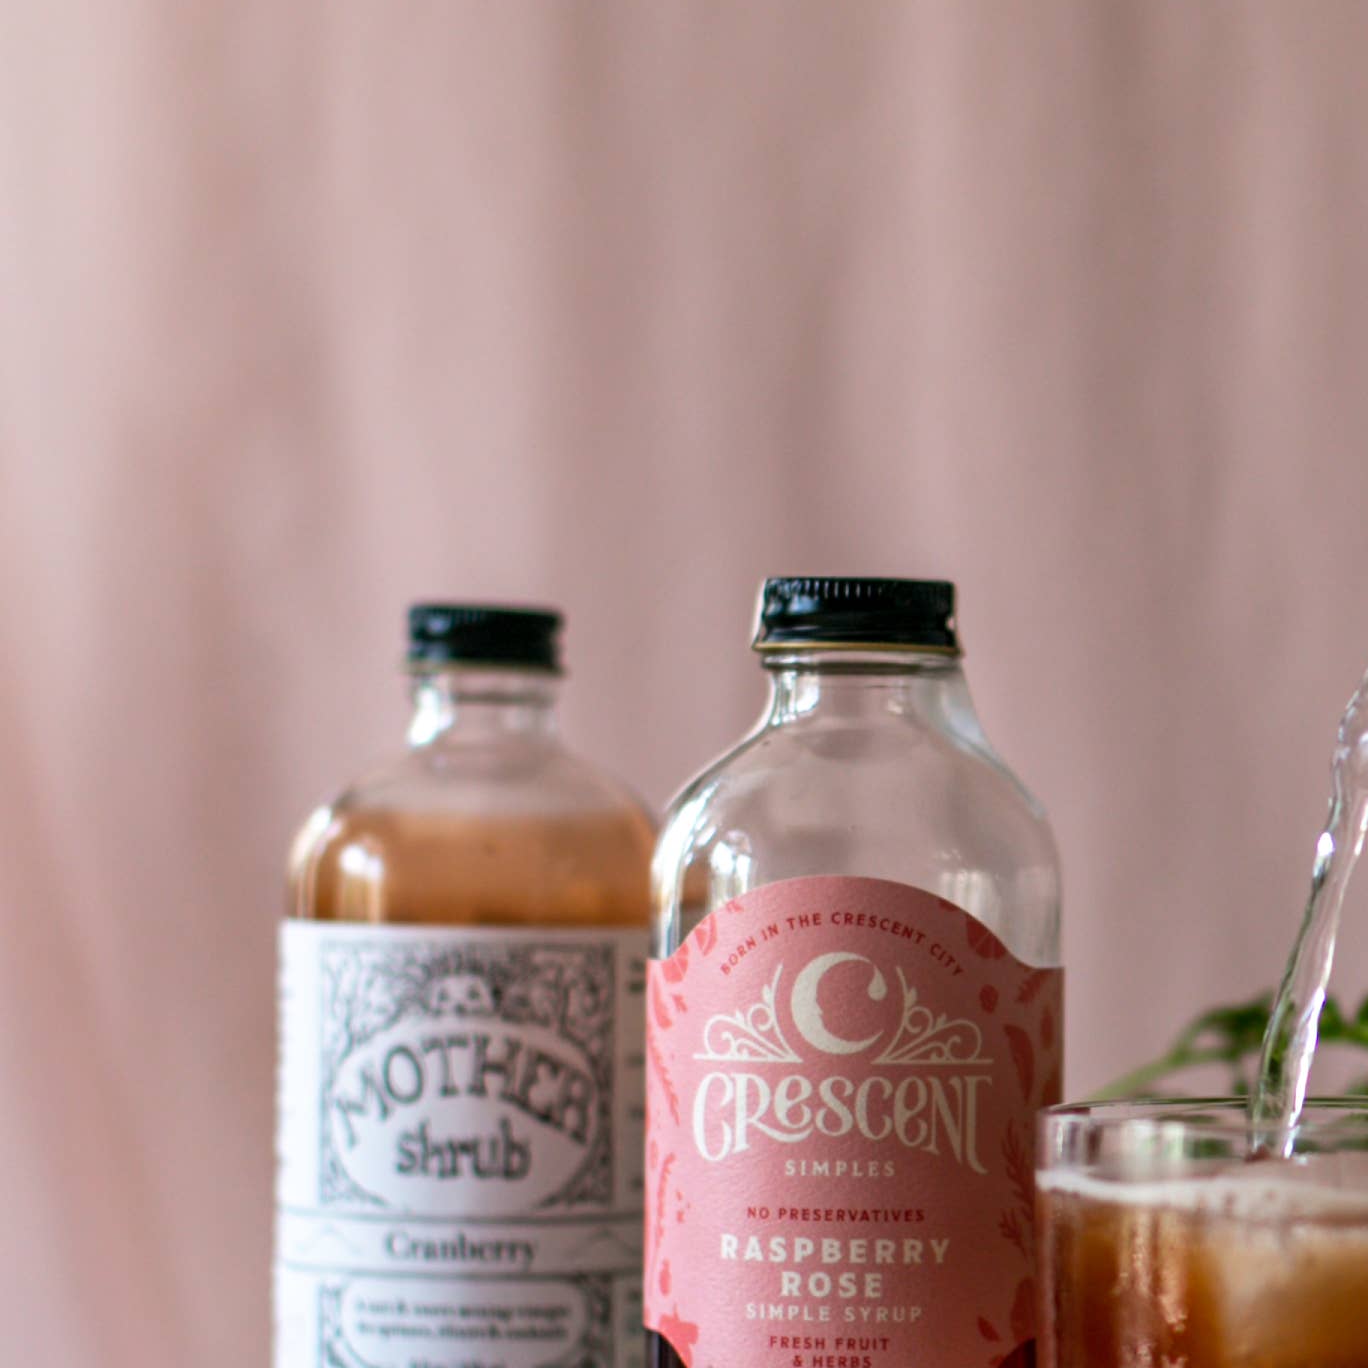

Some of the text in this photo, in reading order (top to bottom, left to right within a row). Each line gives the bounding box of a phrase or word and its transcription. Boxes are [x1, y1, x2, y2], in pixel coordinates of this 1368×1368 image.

[720, 911, 964, 976] BORN IN THE CRESCENT CITY
[334, 1034, 588, 1146] MOTHER
[396, 1118, 532, 1181] shrub
[785, 1159, 895, 1177] SIMPLES
[747, 1207, 925, 1222] NO PRESERVATIVES
[386, 1233, 535, 1272] Cranberry
[720, 1233, 950, 1264] RASPBERRY
[780, 1271, 883, 1298] ROSE
[746, 1303, 923, 1322] SIMPLE SYRUP
[770, 1336, 890, 1351] FRESH FRUIT
[793, 1355, 872, 1368] & HERBS
